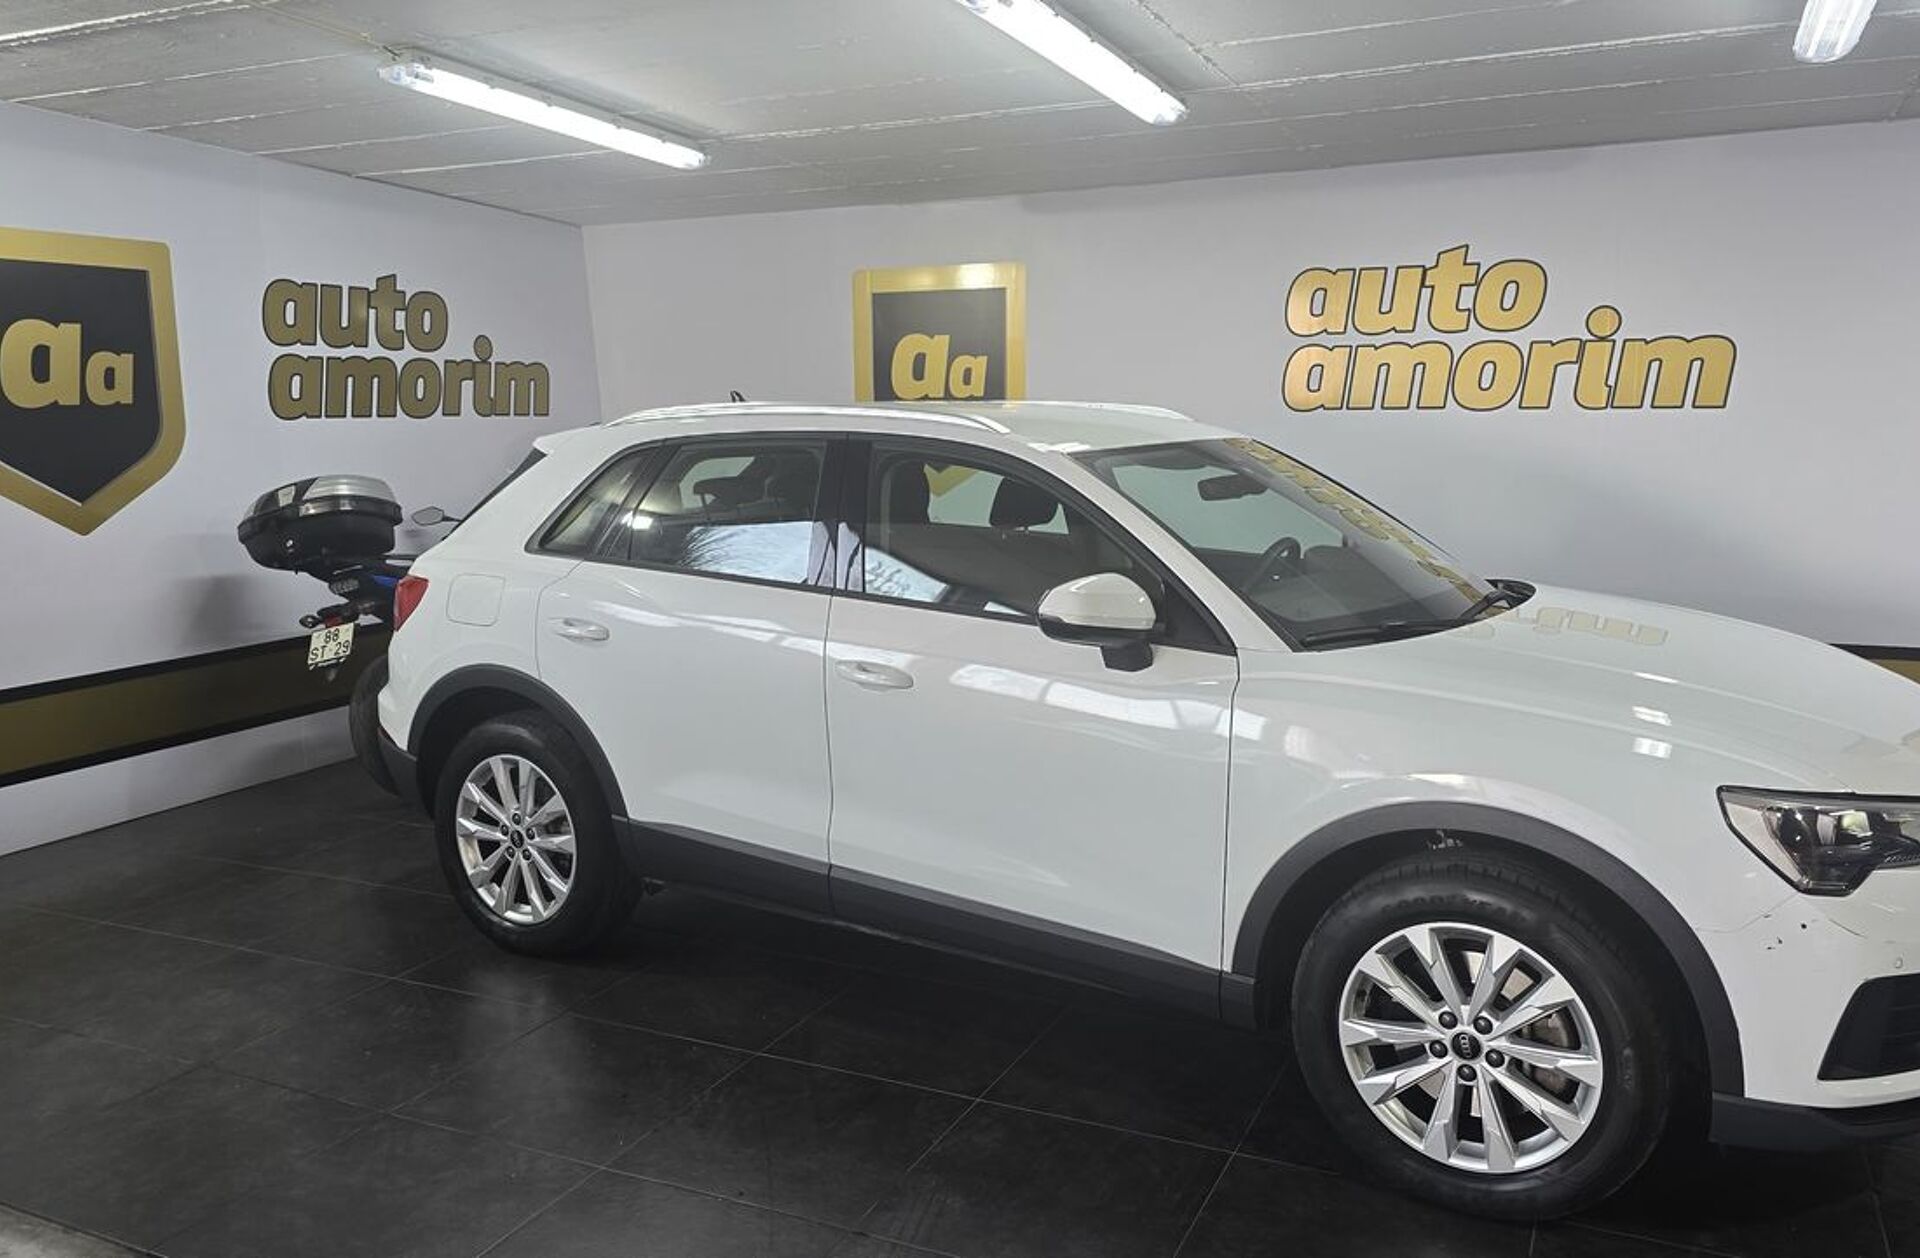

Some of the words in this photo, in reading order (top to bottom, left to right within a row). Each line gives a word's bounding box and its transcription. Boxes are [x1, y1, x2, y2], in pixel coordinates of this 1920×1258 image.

[262, 273, 449, 353] auto
[1285, 244, 1547, 337] auto
[268, 334, 550, 421] amorim
[1282, 305, 1737, 412] amorim
[323, 628, 340, 644] 88
